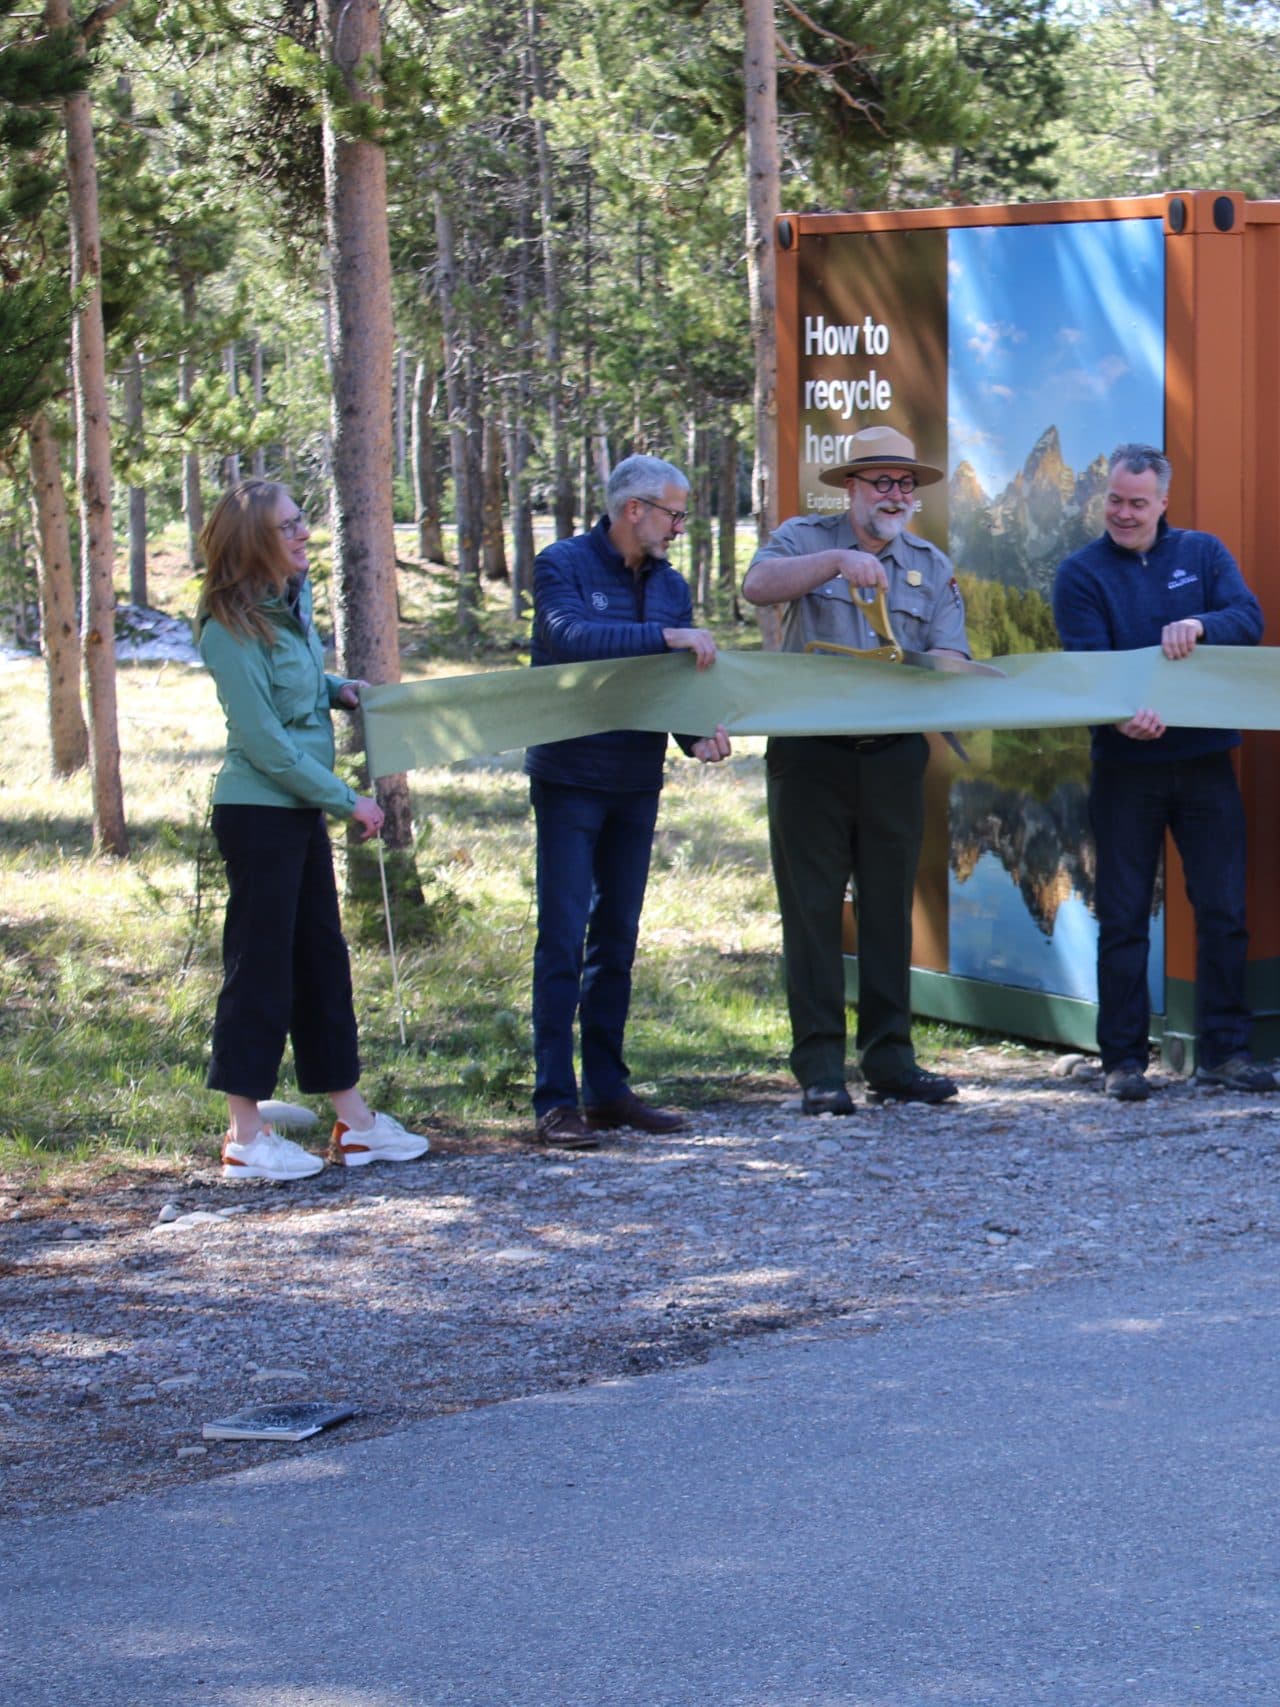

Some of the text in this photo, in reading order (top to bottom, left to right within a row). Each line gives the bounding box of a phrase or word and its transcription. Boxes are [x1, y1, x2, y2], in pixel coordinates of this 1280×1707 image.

[805, 315, 890, 356] How to
[804, 369, 891, 420] recycle
[807, 492, 842, 513] Explore
